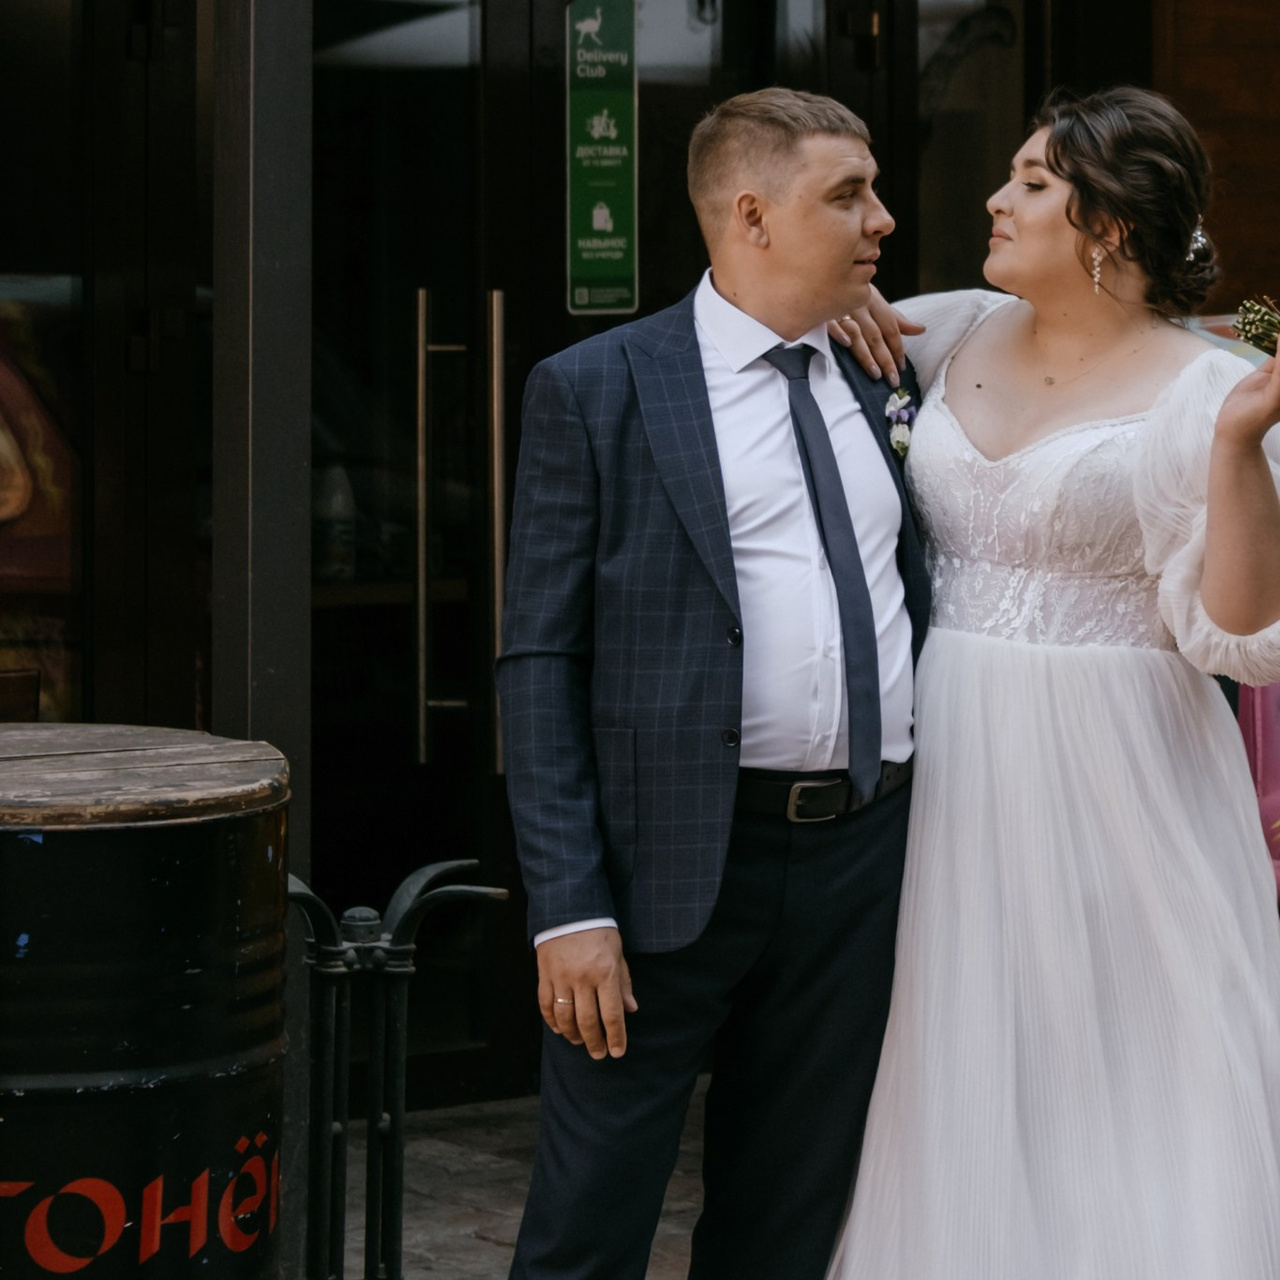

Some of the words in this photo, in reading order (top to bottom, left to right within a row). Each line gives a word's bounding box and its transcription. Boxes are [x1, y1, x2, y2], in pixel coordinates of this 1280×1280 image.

[577, 49, 628, 66] Delivery
[577, 64, 606, 77] Club
[576, 145, 628, 158] ДОСТАВКА
